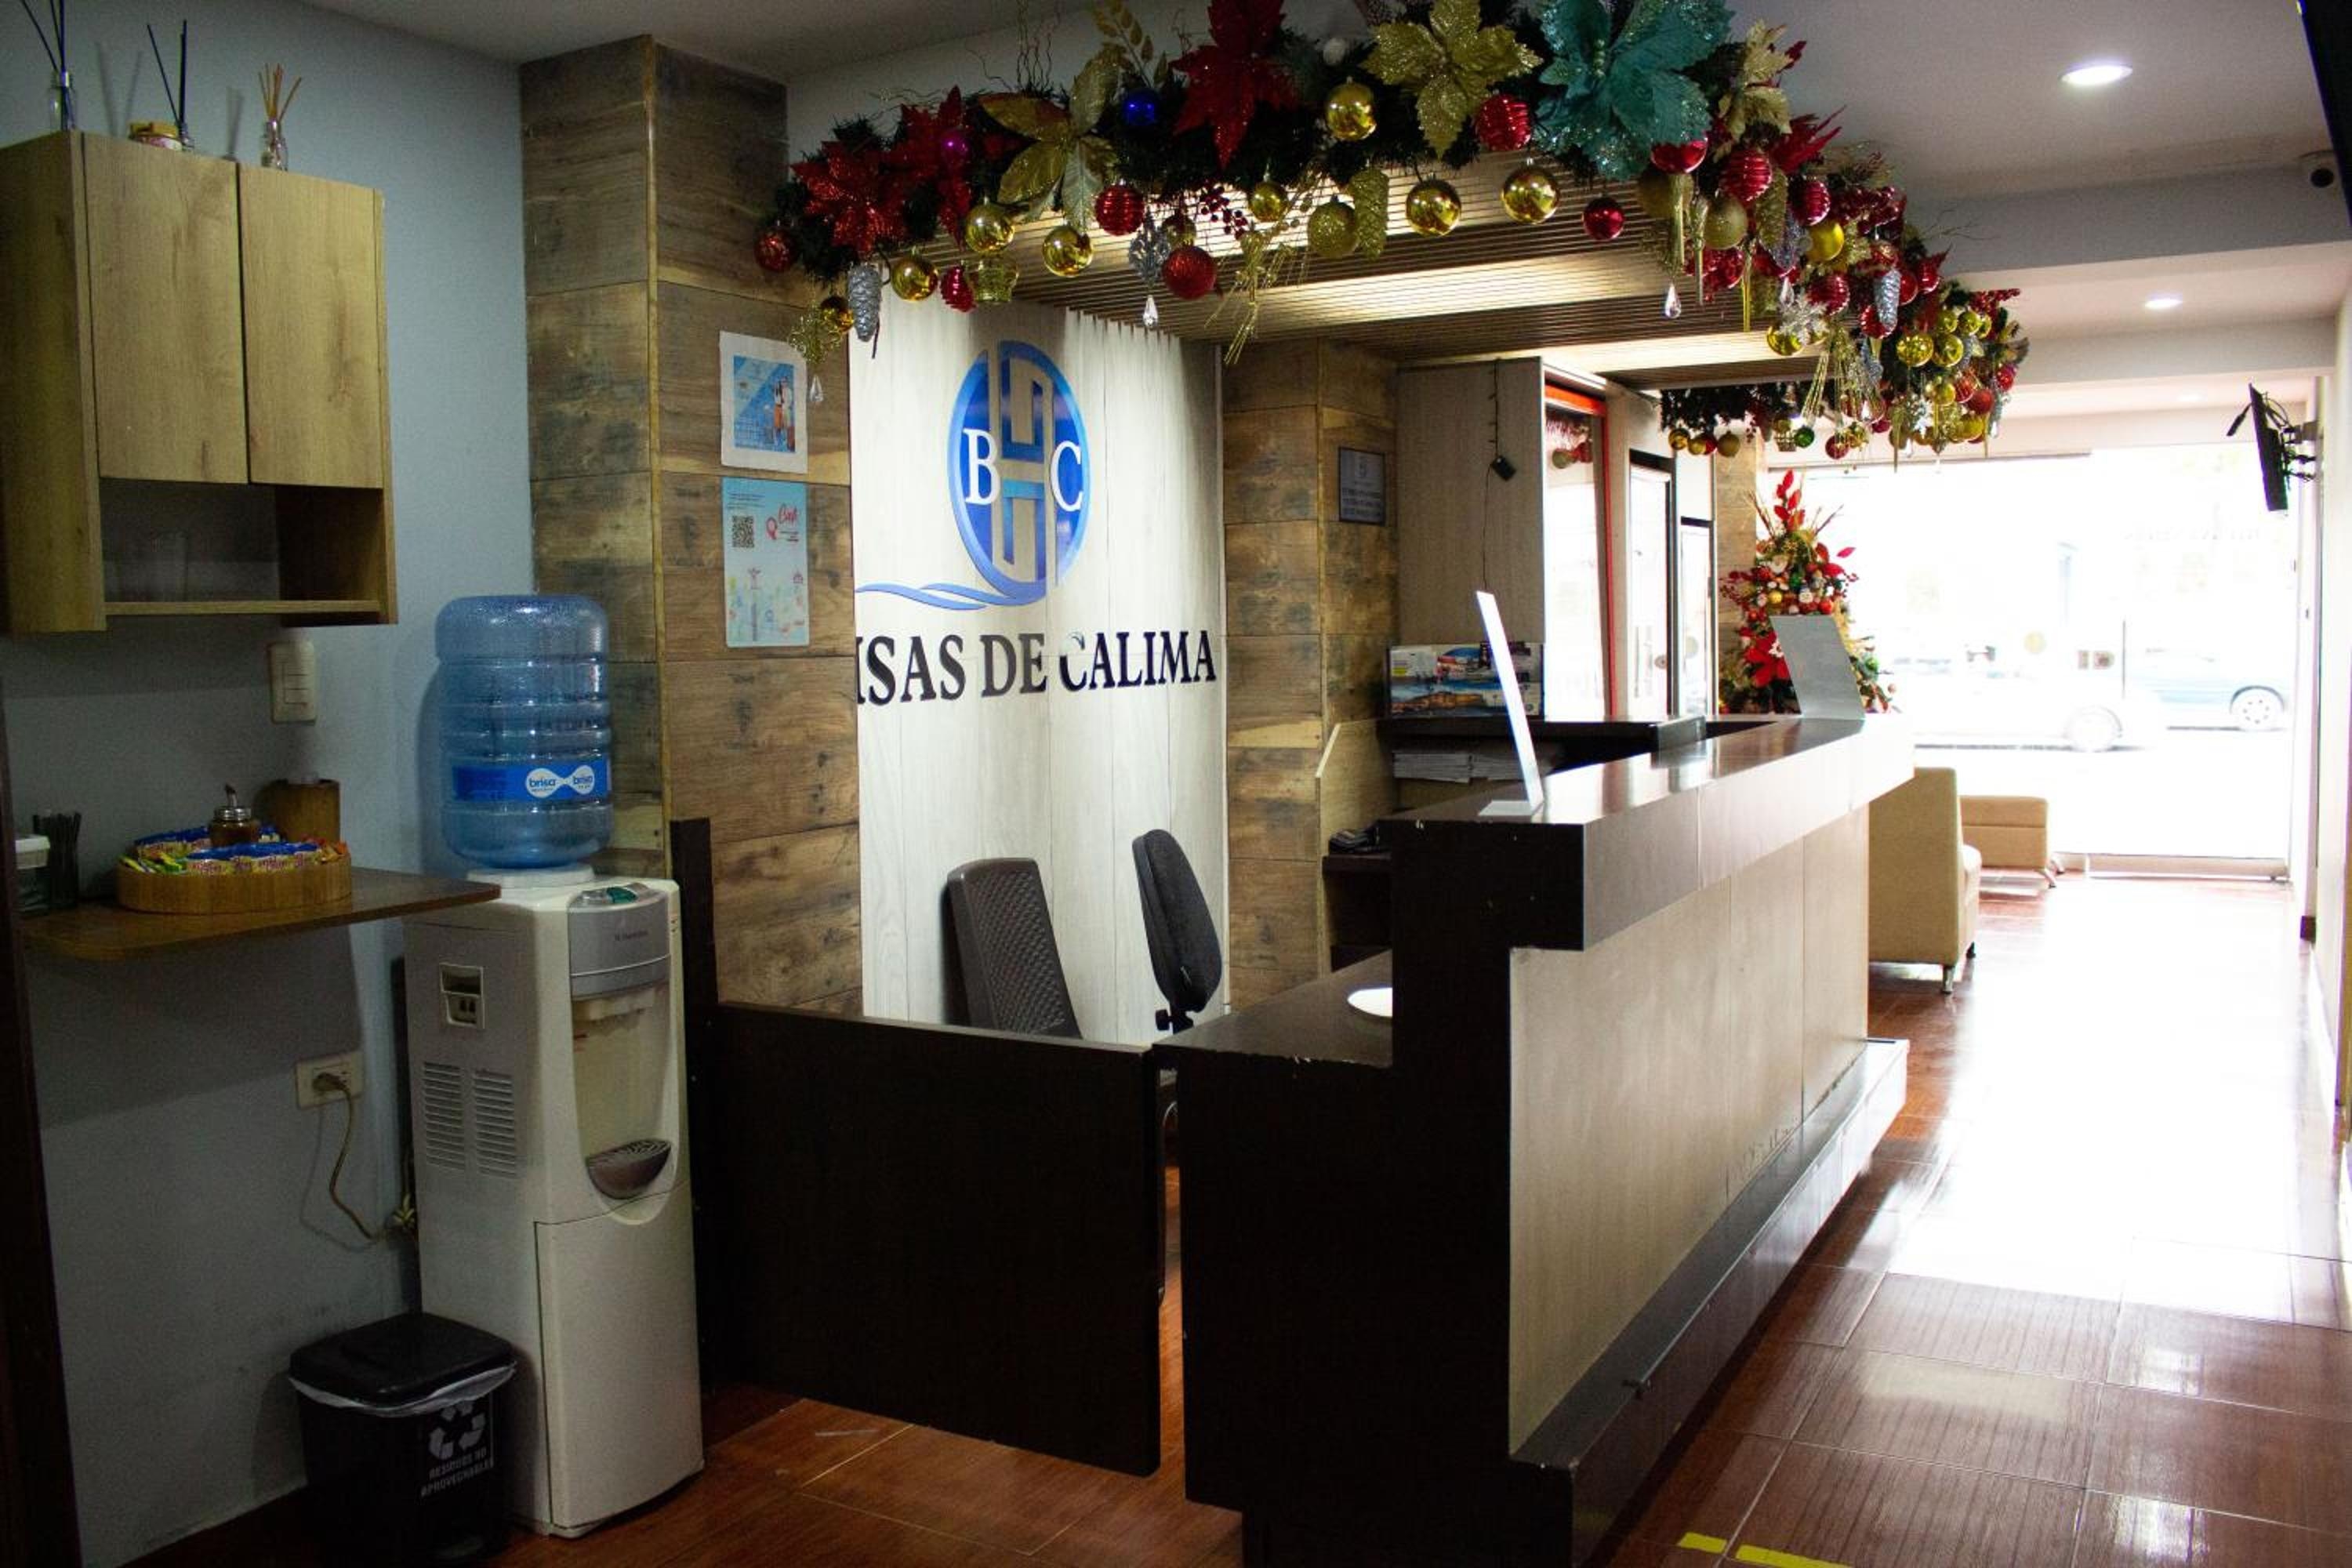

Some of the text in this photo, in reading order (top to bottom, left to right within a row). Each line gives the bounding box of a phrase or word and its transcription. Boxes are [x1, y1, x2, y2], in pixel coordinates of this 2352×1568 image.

[1051, 441, 1083, 512] C
[980, 633, 1047, 698] DE
[1059, 630, 1217, 691] CALIMA
[529, 778, 556, 787] brisa
